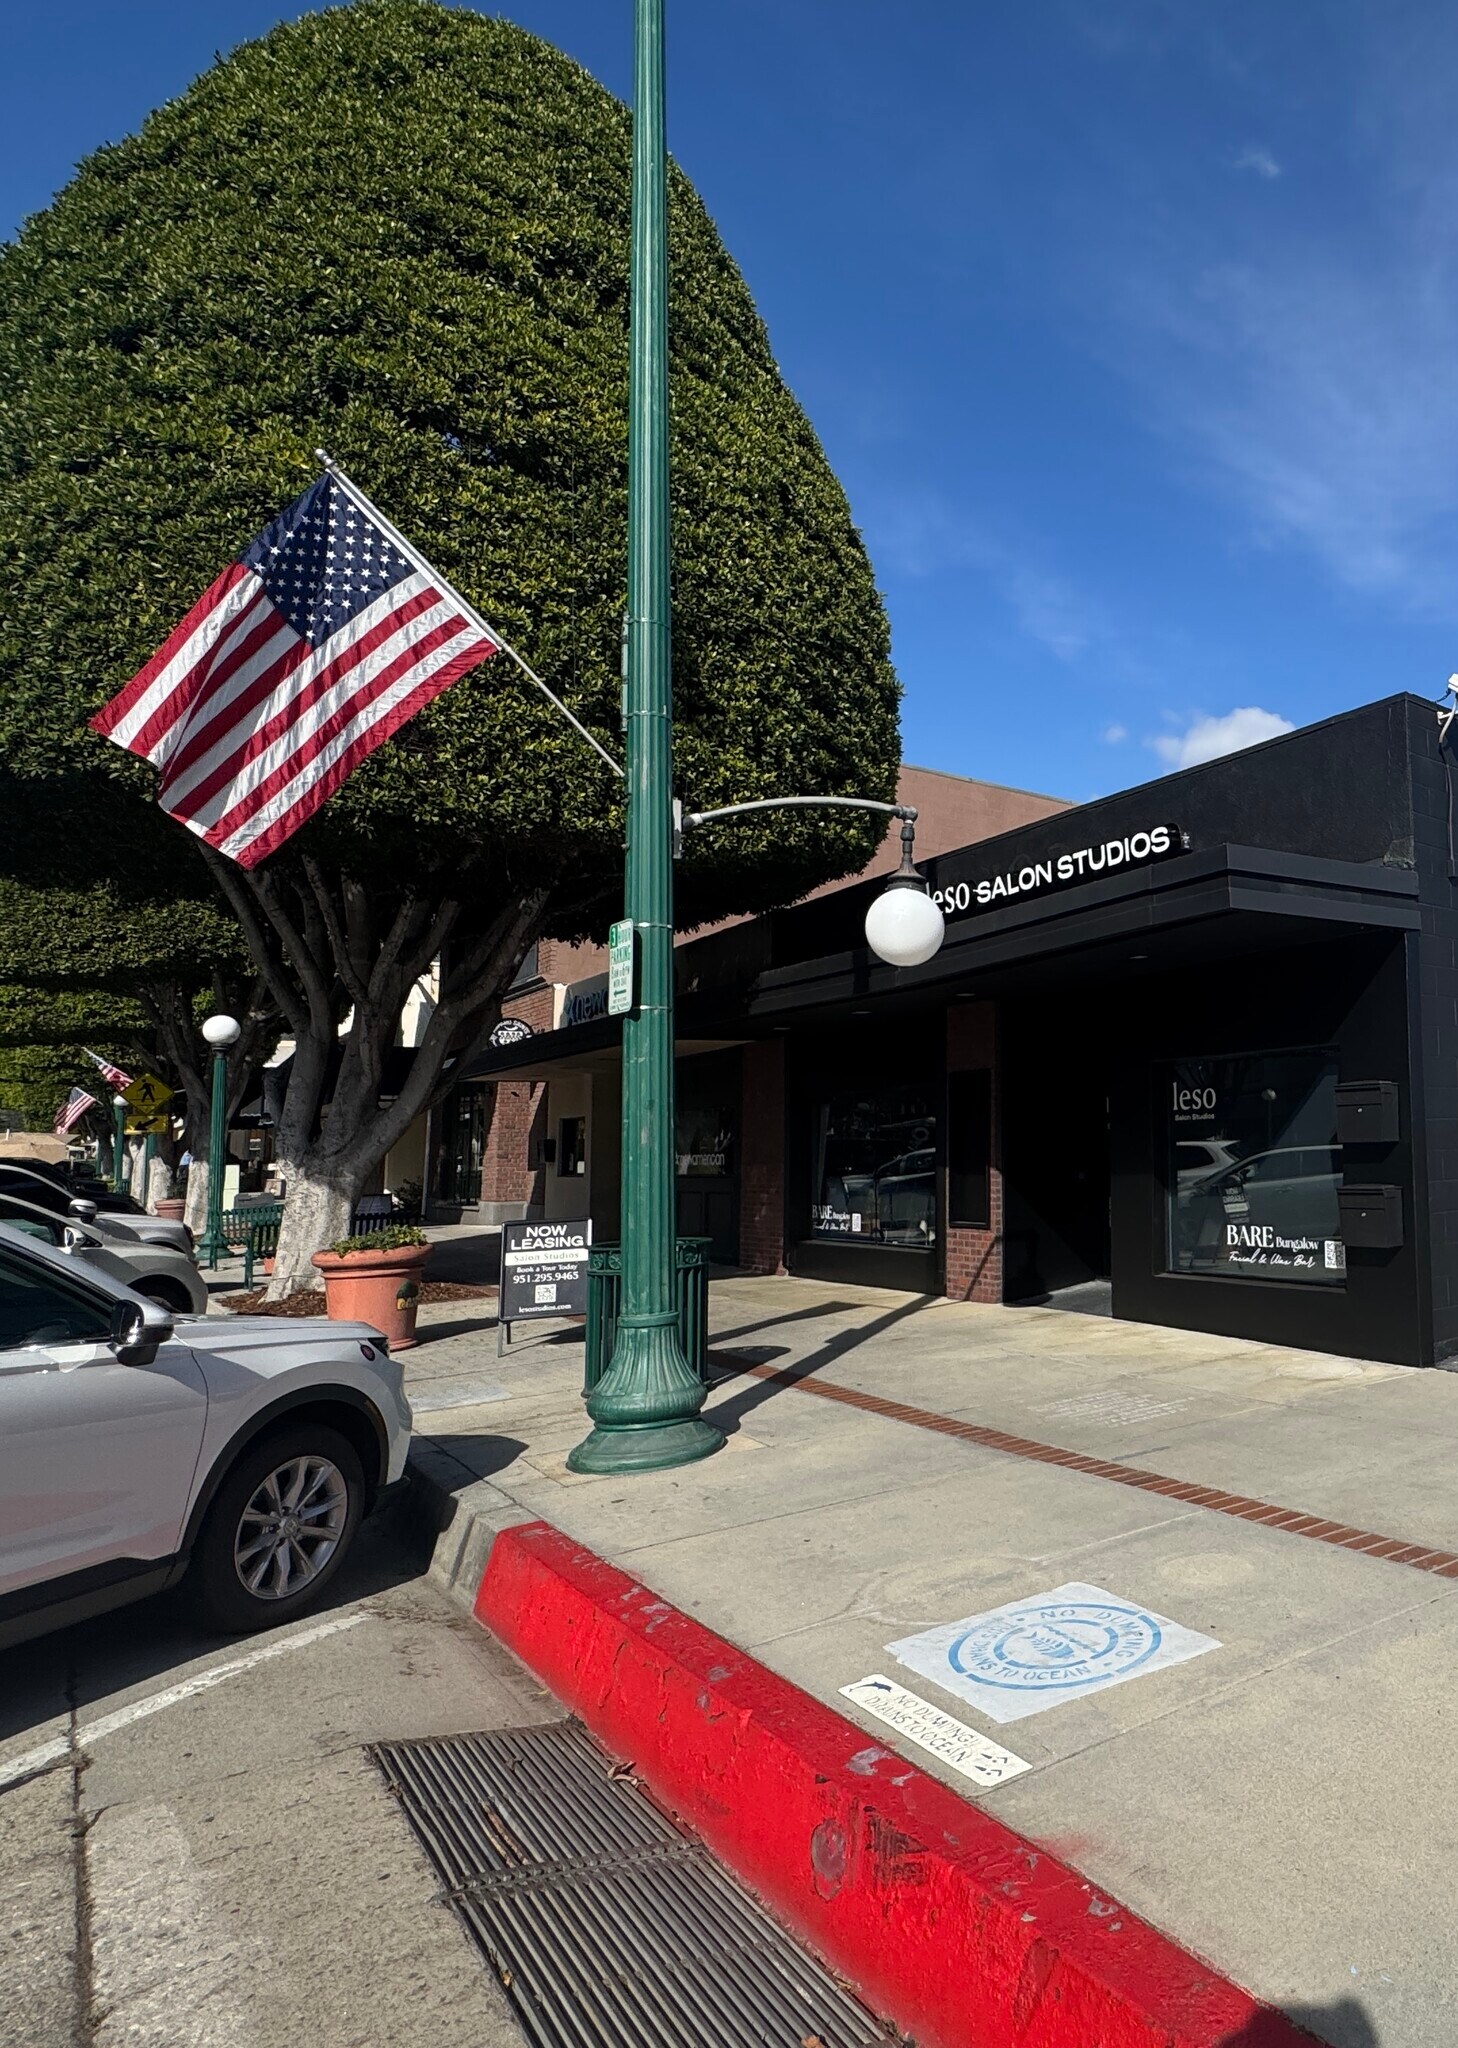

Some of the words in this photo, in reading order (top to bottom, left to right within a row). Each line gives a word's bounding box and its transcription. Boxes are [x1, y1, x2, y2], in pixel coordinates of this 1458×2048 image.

[976, 860, 1053, 905] SALON
[1057, 826, 1171, 880] STUDIOS
[610, 945, 631, 964] PARKING
[1173, 1082, 1216, 1111] leso
[812, 1204, 833, 1219] BARE
[526, 1225, 567, 1238] NOW
[1226, 1224, 1274, 1248] BARE
[1276, 1237, 1319, 1253] Bungalow
[511, 1236, 584, 1250] LEASING
[514, 1253, 540, 1262] Salon
[544, 1253, 579, 1262] Studios
[558, 1263, 578, 1271] Today
[513, 1271, 579, 1284] 951.295.9465
[1041, 1609, 1076, 1618] NO
[994, 1667, 1019, 1678] TO
[1023, 1666, 1092, 1681] OCEAN
[895, 1694, 918, 1710] NO
[864, 1695, 910, 1724] DRAINS
[904, 1718, 925, 1735] TO
[920, 1732, 972, 1763] OCEAN
